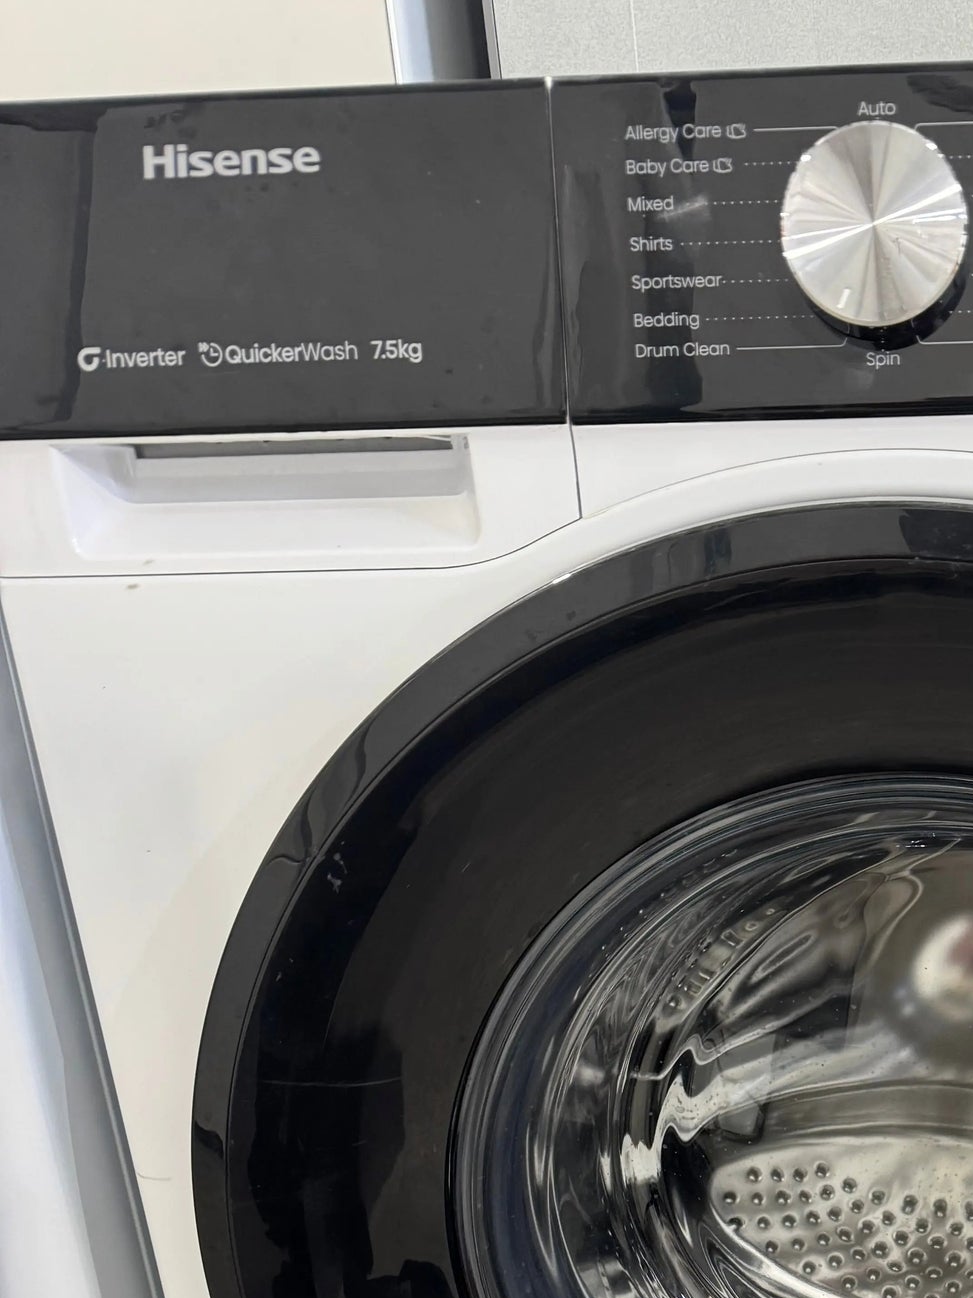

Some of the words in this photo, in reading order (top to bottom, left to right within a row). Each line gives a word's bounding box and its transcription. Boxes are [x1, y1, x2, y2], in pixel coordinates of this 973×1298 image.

[857, 101, 897, 116] Auto
[624, 124, 679, 144] Allergy
[682, 123, 722, 139] Care
[142, 143, 321, 180] Hisense
[625, 158, 666, 178] Baby
[670, 157, 710, 174] Care
[627, 195, 675, 212] Mixed
[629, 236, 673, 252] Shirts
[631, 274, 723, 293] Sportswear
[633, 311, 700, 330] Bedding
[224, 340, 359, 364] QuickerWash
[370, 338, 423, 364] 7.5kg
[635, 343, 680, 359] Drum
[683, 341, 730, 357] Clean
[866, 351, 901, 370] Spin
